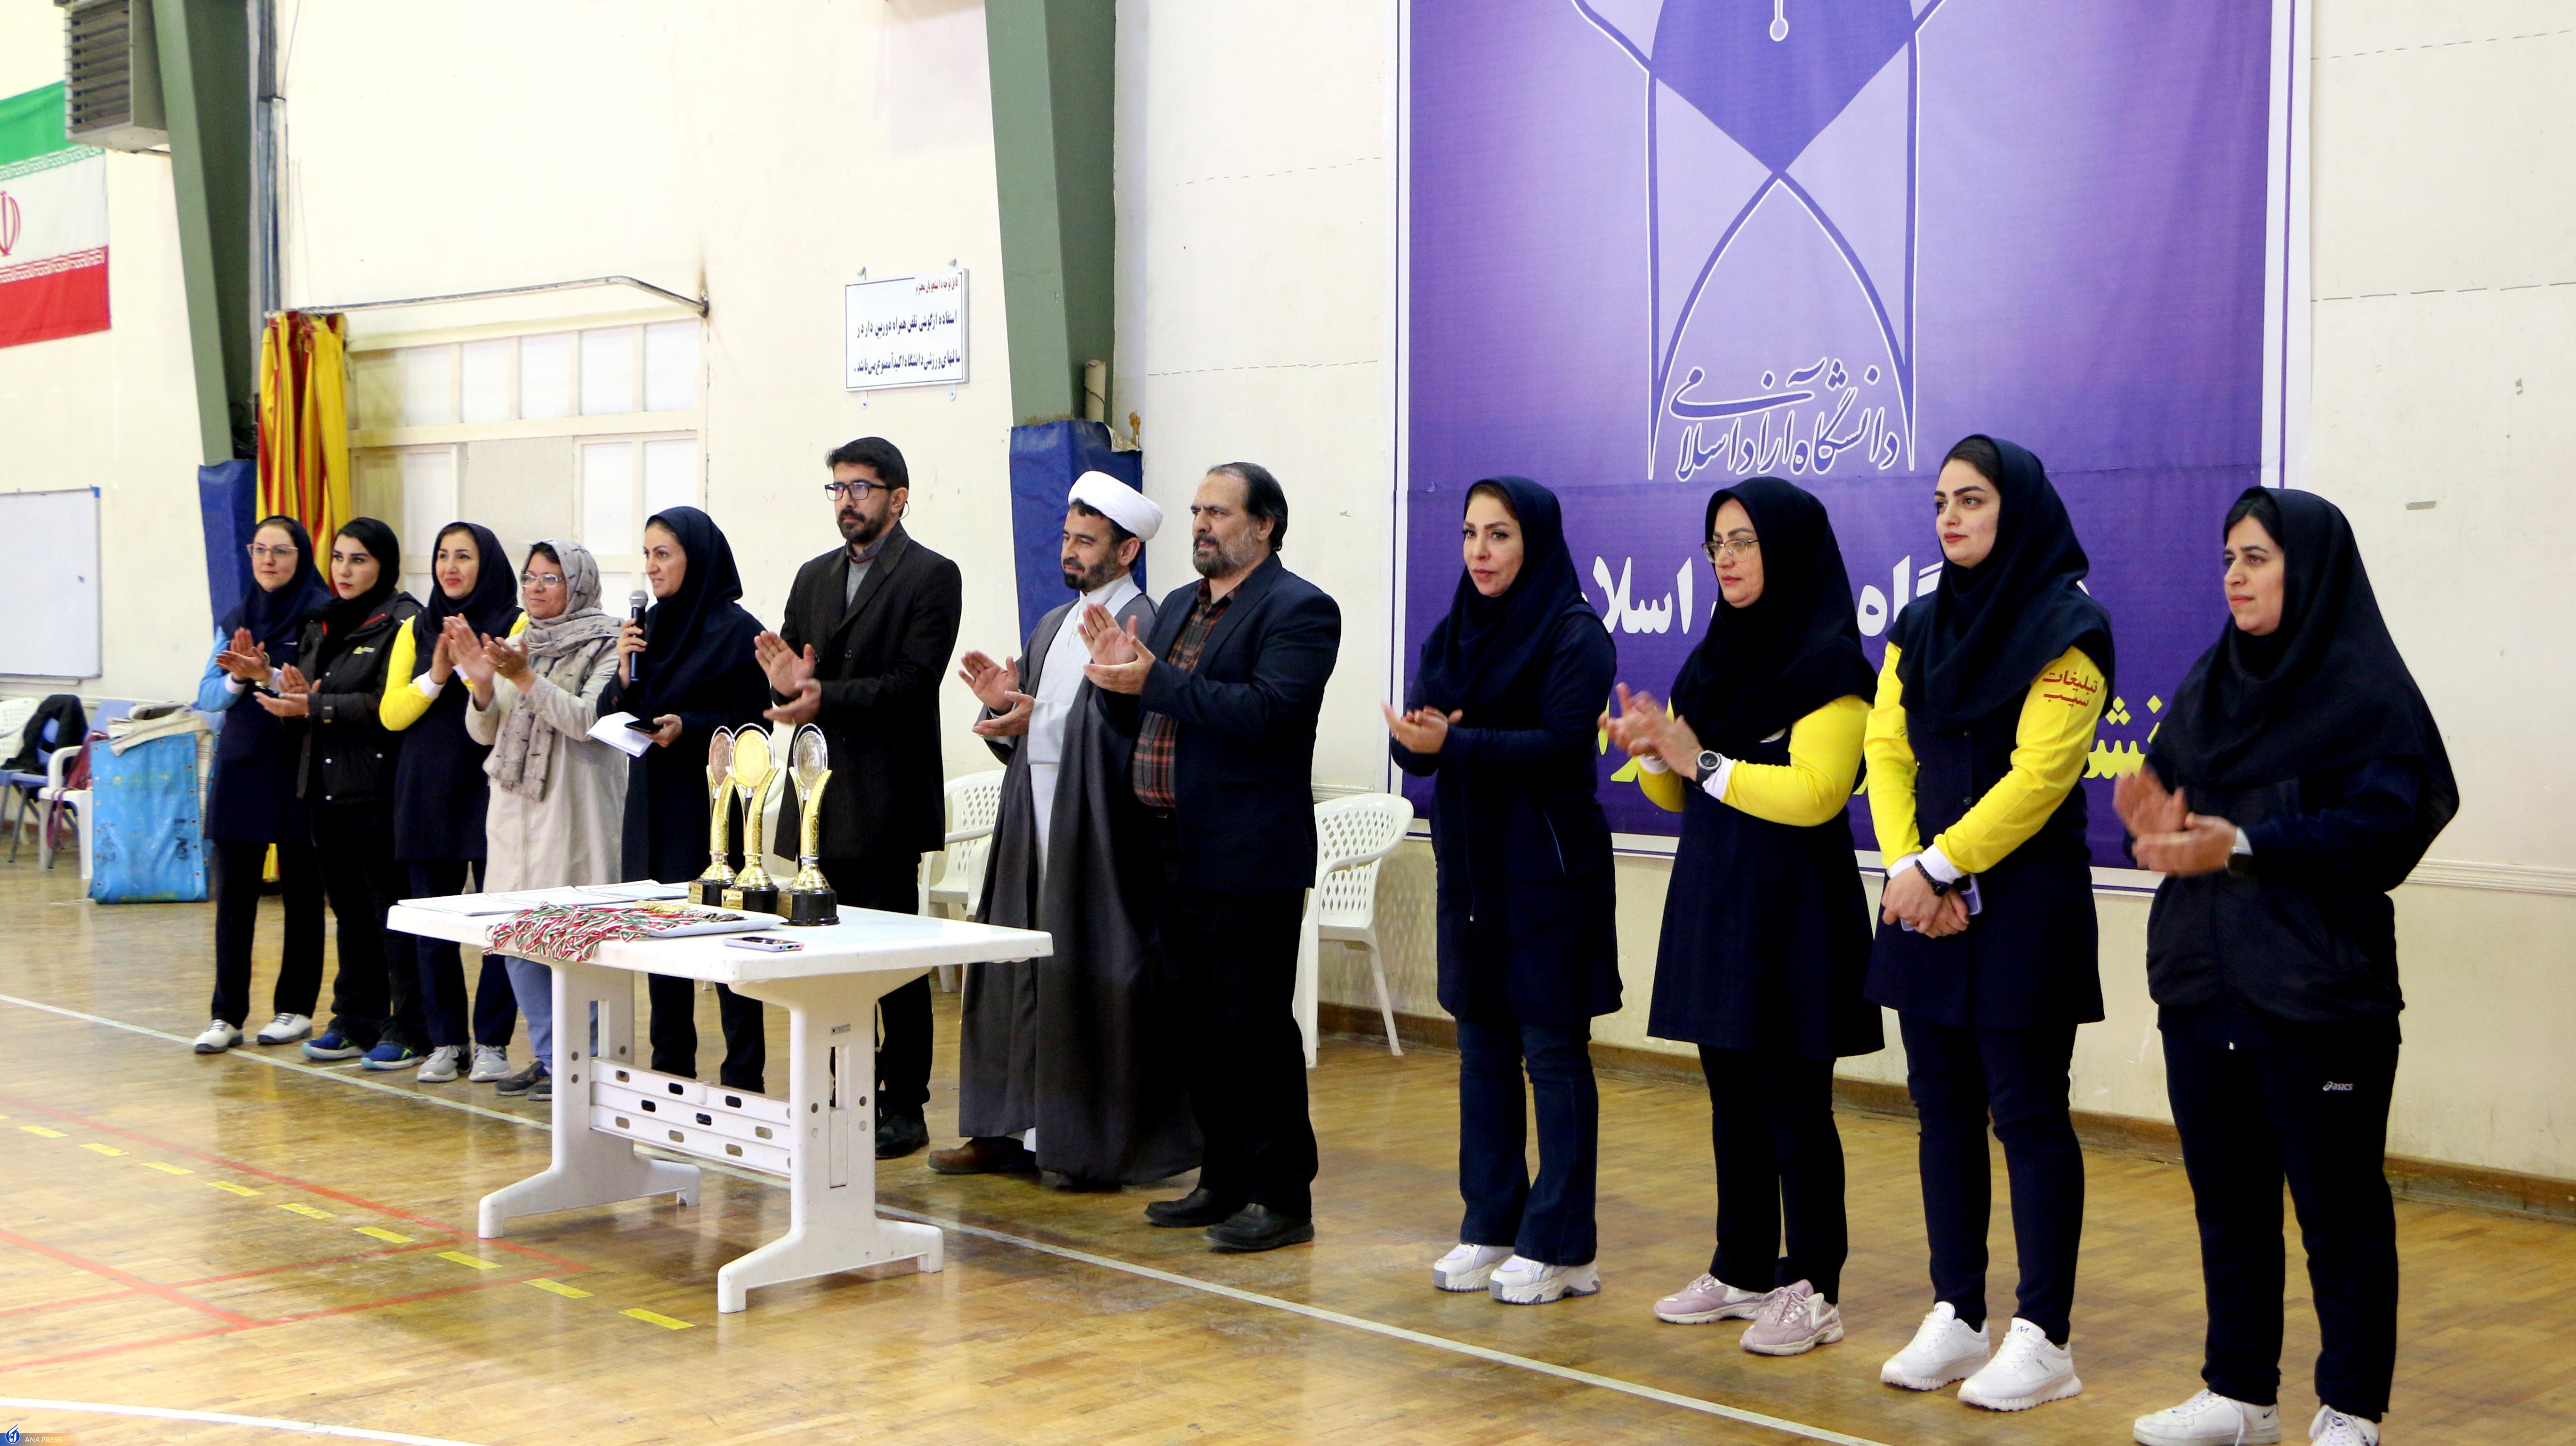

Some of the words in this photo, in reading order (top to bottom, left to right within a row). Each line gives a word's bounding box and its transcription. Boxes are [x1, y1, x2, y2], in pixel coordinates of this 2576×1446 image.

[893, 316, 906, 335] همراه
[907, 314, 918, 333] تلفن
[919, 313, 933, 332] گوشی
[932, 312, 937, 330] از
[939, 309, 957, 325] استفاده
[875, 320, 891, 339] دوربین
[876, 359, 891, 375] ممنوع
[904, 352, 923, 367] دانشگاه
[924, 352, 941, 370] ورزشی
[1790, 357, 1900, 474] دانشگاه
[2042, 670, 2098, 695] تبلیغات
[2043, 693, 2089, 707] سیب
